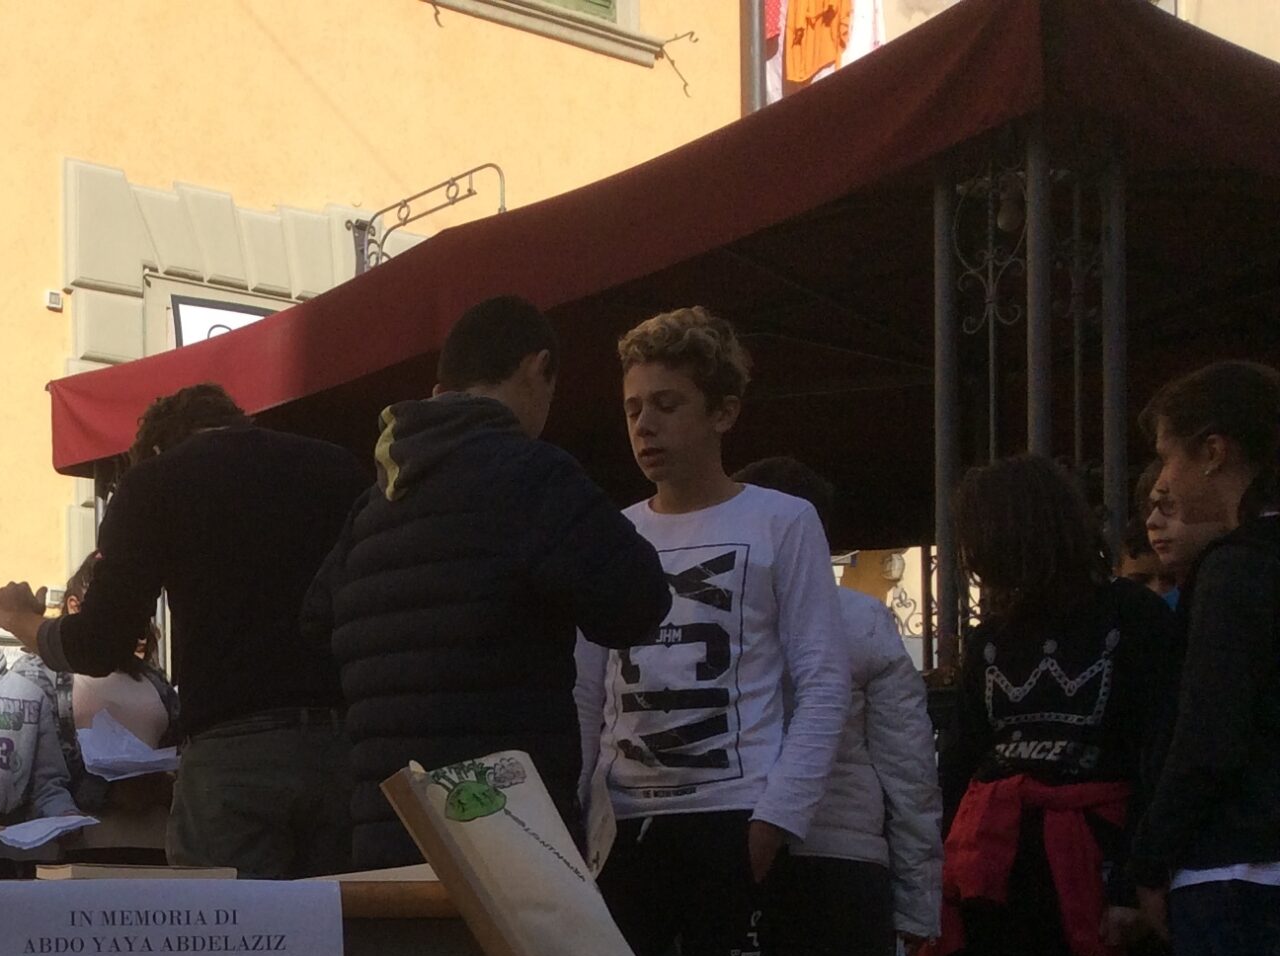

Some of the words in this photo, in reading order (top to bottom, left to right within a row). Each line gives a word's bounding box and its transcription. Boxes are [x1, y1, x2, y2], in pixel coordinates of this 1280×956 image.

[68, 909, 95, 929] IN
[100, 909, 207, 928] MEMORIA
[214, 908, 239, 927] DI
[22, 936, 86, 955] ABDO
[91, 935, 155, 954] YAYA
[159, 933, 288, 953] ABDELAZIZ
